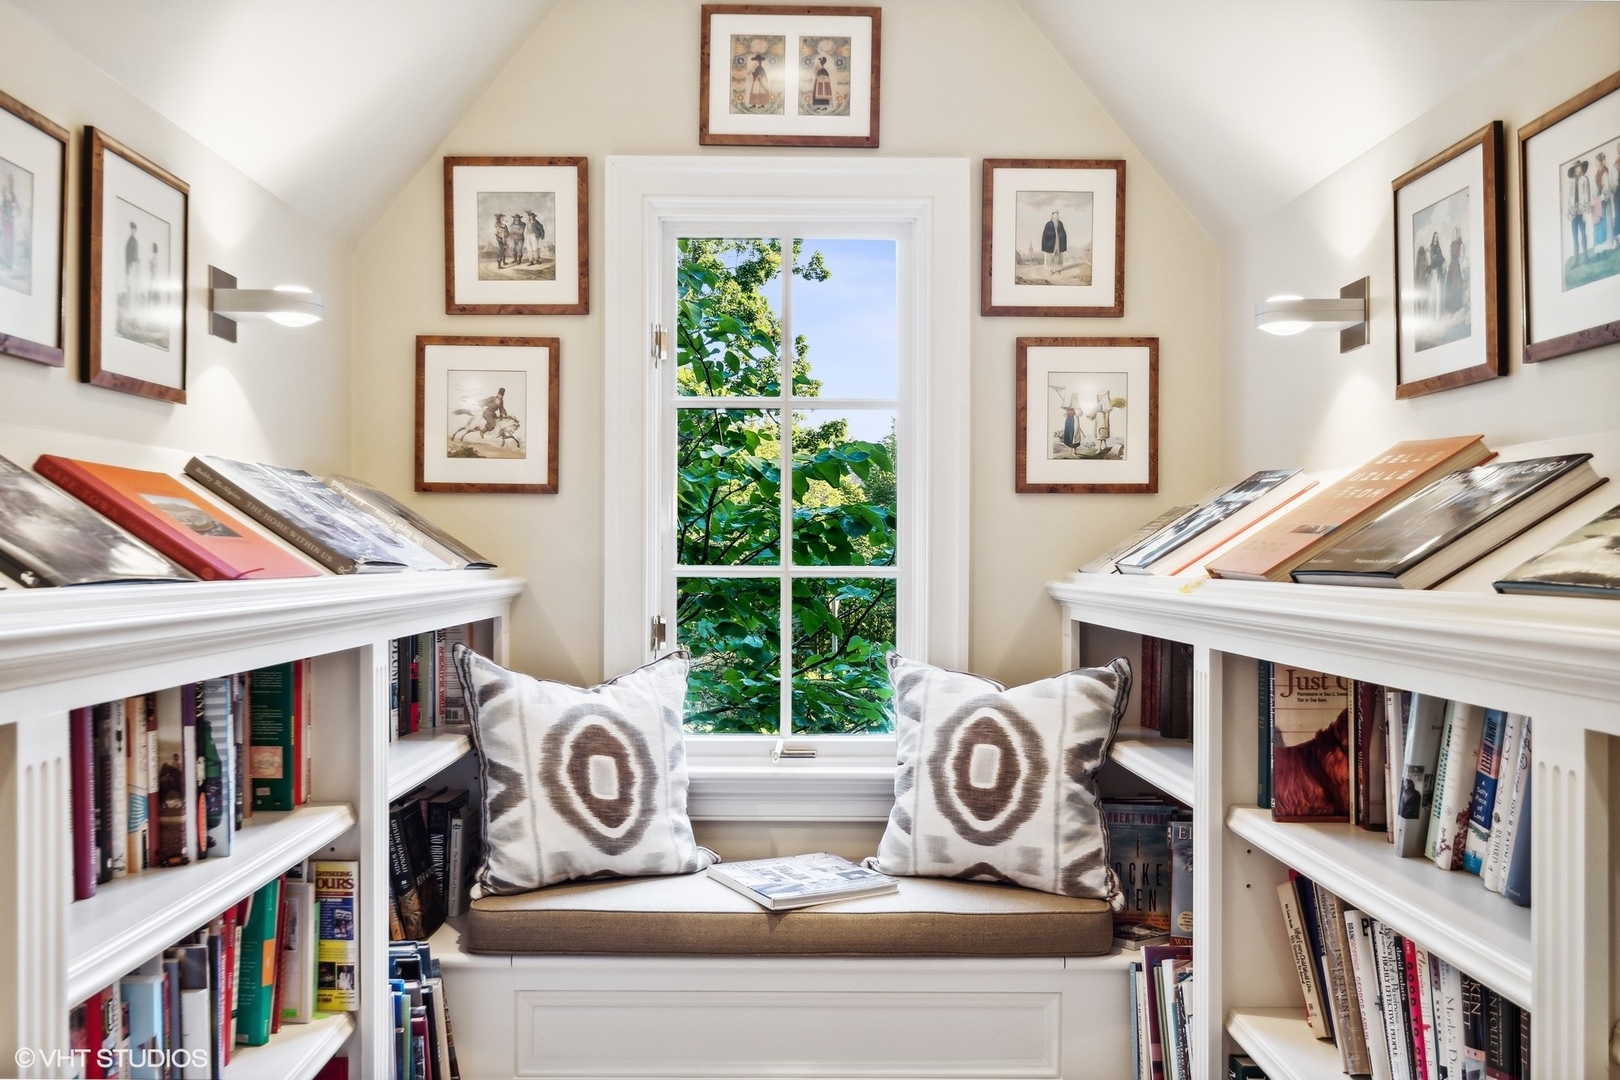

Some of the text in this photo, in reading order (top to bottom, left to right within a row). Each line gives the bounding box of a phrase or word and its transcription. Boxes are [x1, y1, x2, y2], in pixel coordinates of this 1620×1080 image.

[246, 501, 263, 515] THE
[263, 513, 288, 533] HOME
[289, 530, 321, 555] WITHIN
[321, 551, 333, 563] US
[1280, 669, 1329, 698] Just
[1480, 717, 1498, 775] JIMMY BUFFETT
[1475, 794, 1487, 806] Piece
[1477, 786, 1488, 798] Salty
[1107, 812, 1136, 823] OBERT
[1473, 811, 1485, 822] Land
[391, 819, 408, 874] KRISTIN HANNAH
[430, 833, 444, 843] NO
[1490, 828, 1502, 863] RICHARD
[391, 851, 401, 875] WINDS
[1116, 862, 1162, 886] OCKE
[316, 878, 355, 889] OURS
[1328, 903, 1336, 919] JIM
[1292, 927, 1302, 940] What
[1294, 940, 1305, 954] Every
[1298, 954, 1308, 966] Child
[1384, 940, 1396, 962] Soul
[1395, 946, 1404, 969] david
[1301, 966, 1311, 980] Would
[1380, 955, 1391, 983] HIGHLY
[1405, 961, 1417, 1006] GOOD
[1415, 949, 1428, 996] Cleaving
[1334, 948, 1350, 1020] INVESTMENT
[1398, 971, 1407, 1000] sedaris
[1469, 982, 1481, 1015] KEN
[1355, 976, 1365, 1008] GEORGE
[1360, 1010, 1370, 1039] CARLIN
[1384, 985, 1396, 1026] EFFECTIVE
[1389, 982, 1404, 1023] Business
[1461, 972, 1471, 1029] OLLETT
[1411, 1016, 1420, 1036] TO
[1444, 996, 1459, 1078] Merle's Doo
[1489, 1010, 1499, 1065] FOLLETT
[1389, 1028, 1400, 1057] PEOPLE
[1413, 1046, 1424, 1080] GRE
